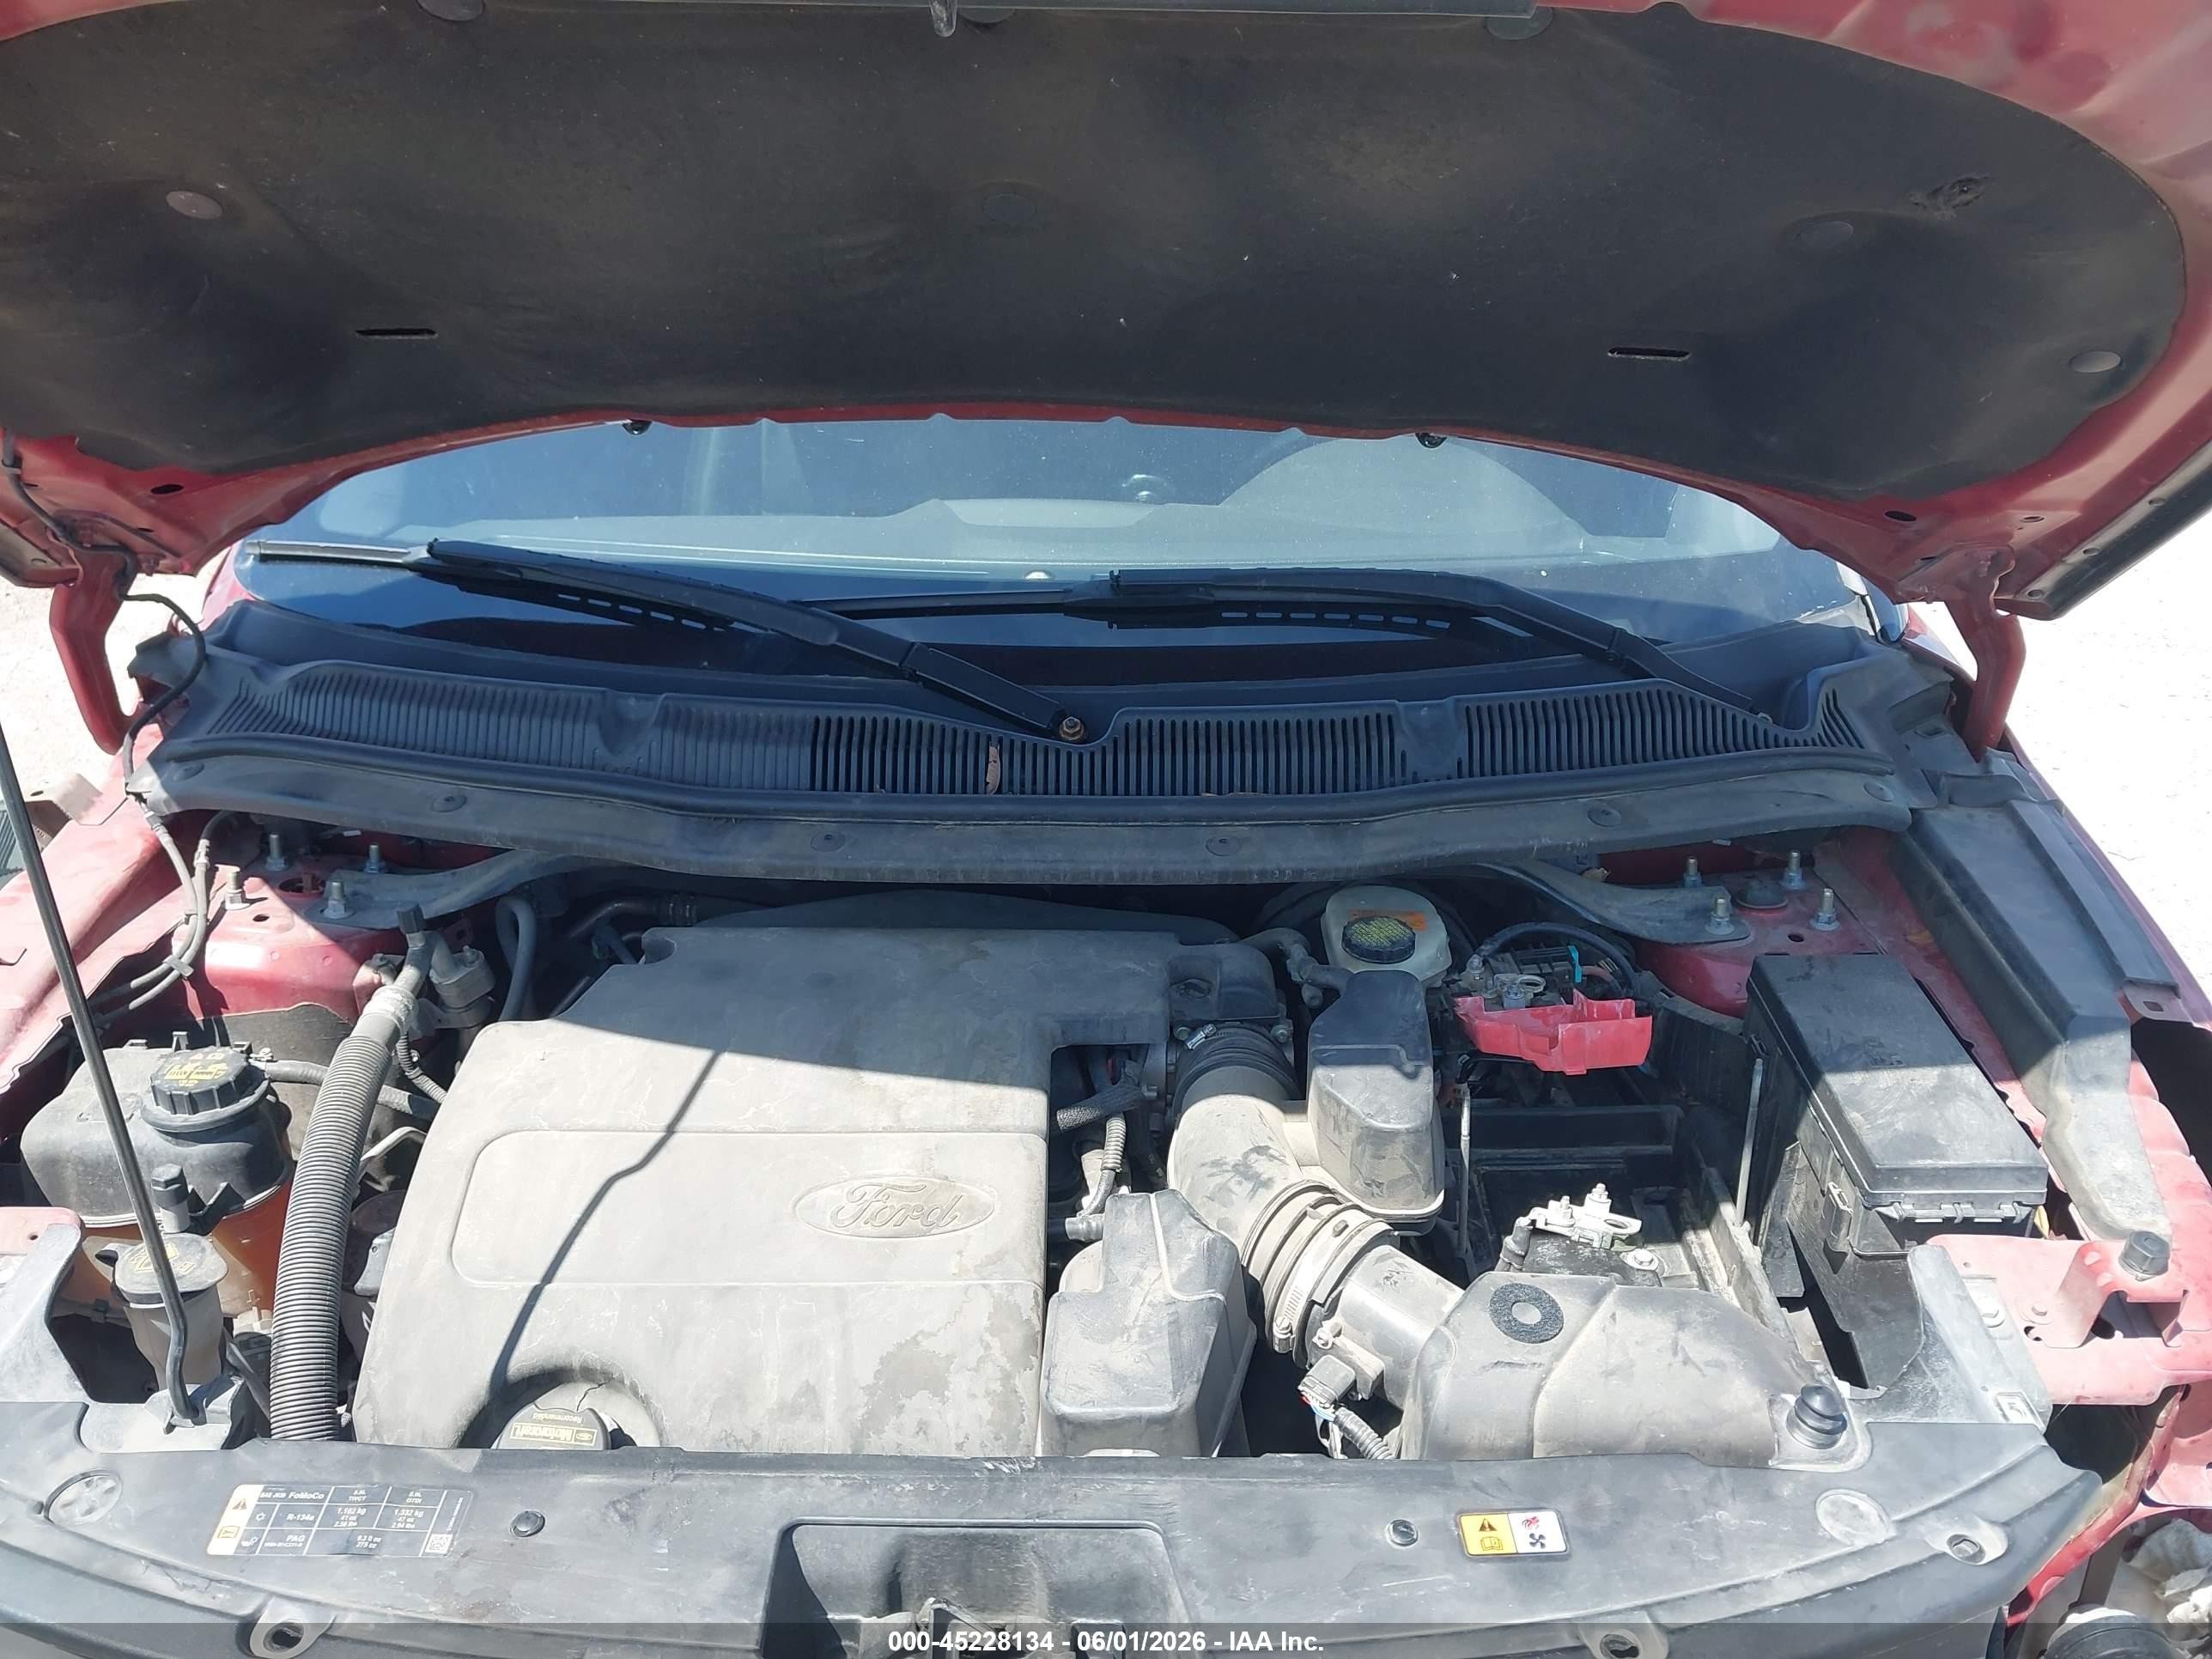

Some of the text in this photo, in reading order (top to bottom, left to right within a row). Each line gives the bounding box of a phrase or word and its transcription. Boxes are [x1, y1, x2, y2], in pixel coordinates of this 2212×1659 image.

[829, 1182, 963, 1229] Ford
[533, 1413, 583, 1424] Recommended
[514, 1425, 573, 1442] Motorcraft
[357, 1507, 367, 1516] kg
[414, 1510, 425, 1518] kg
